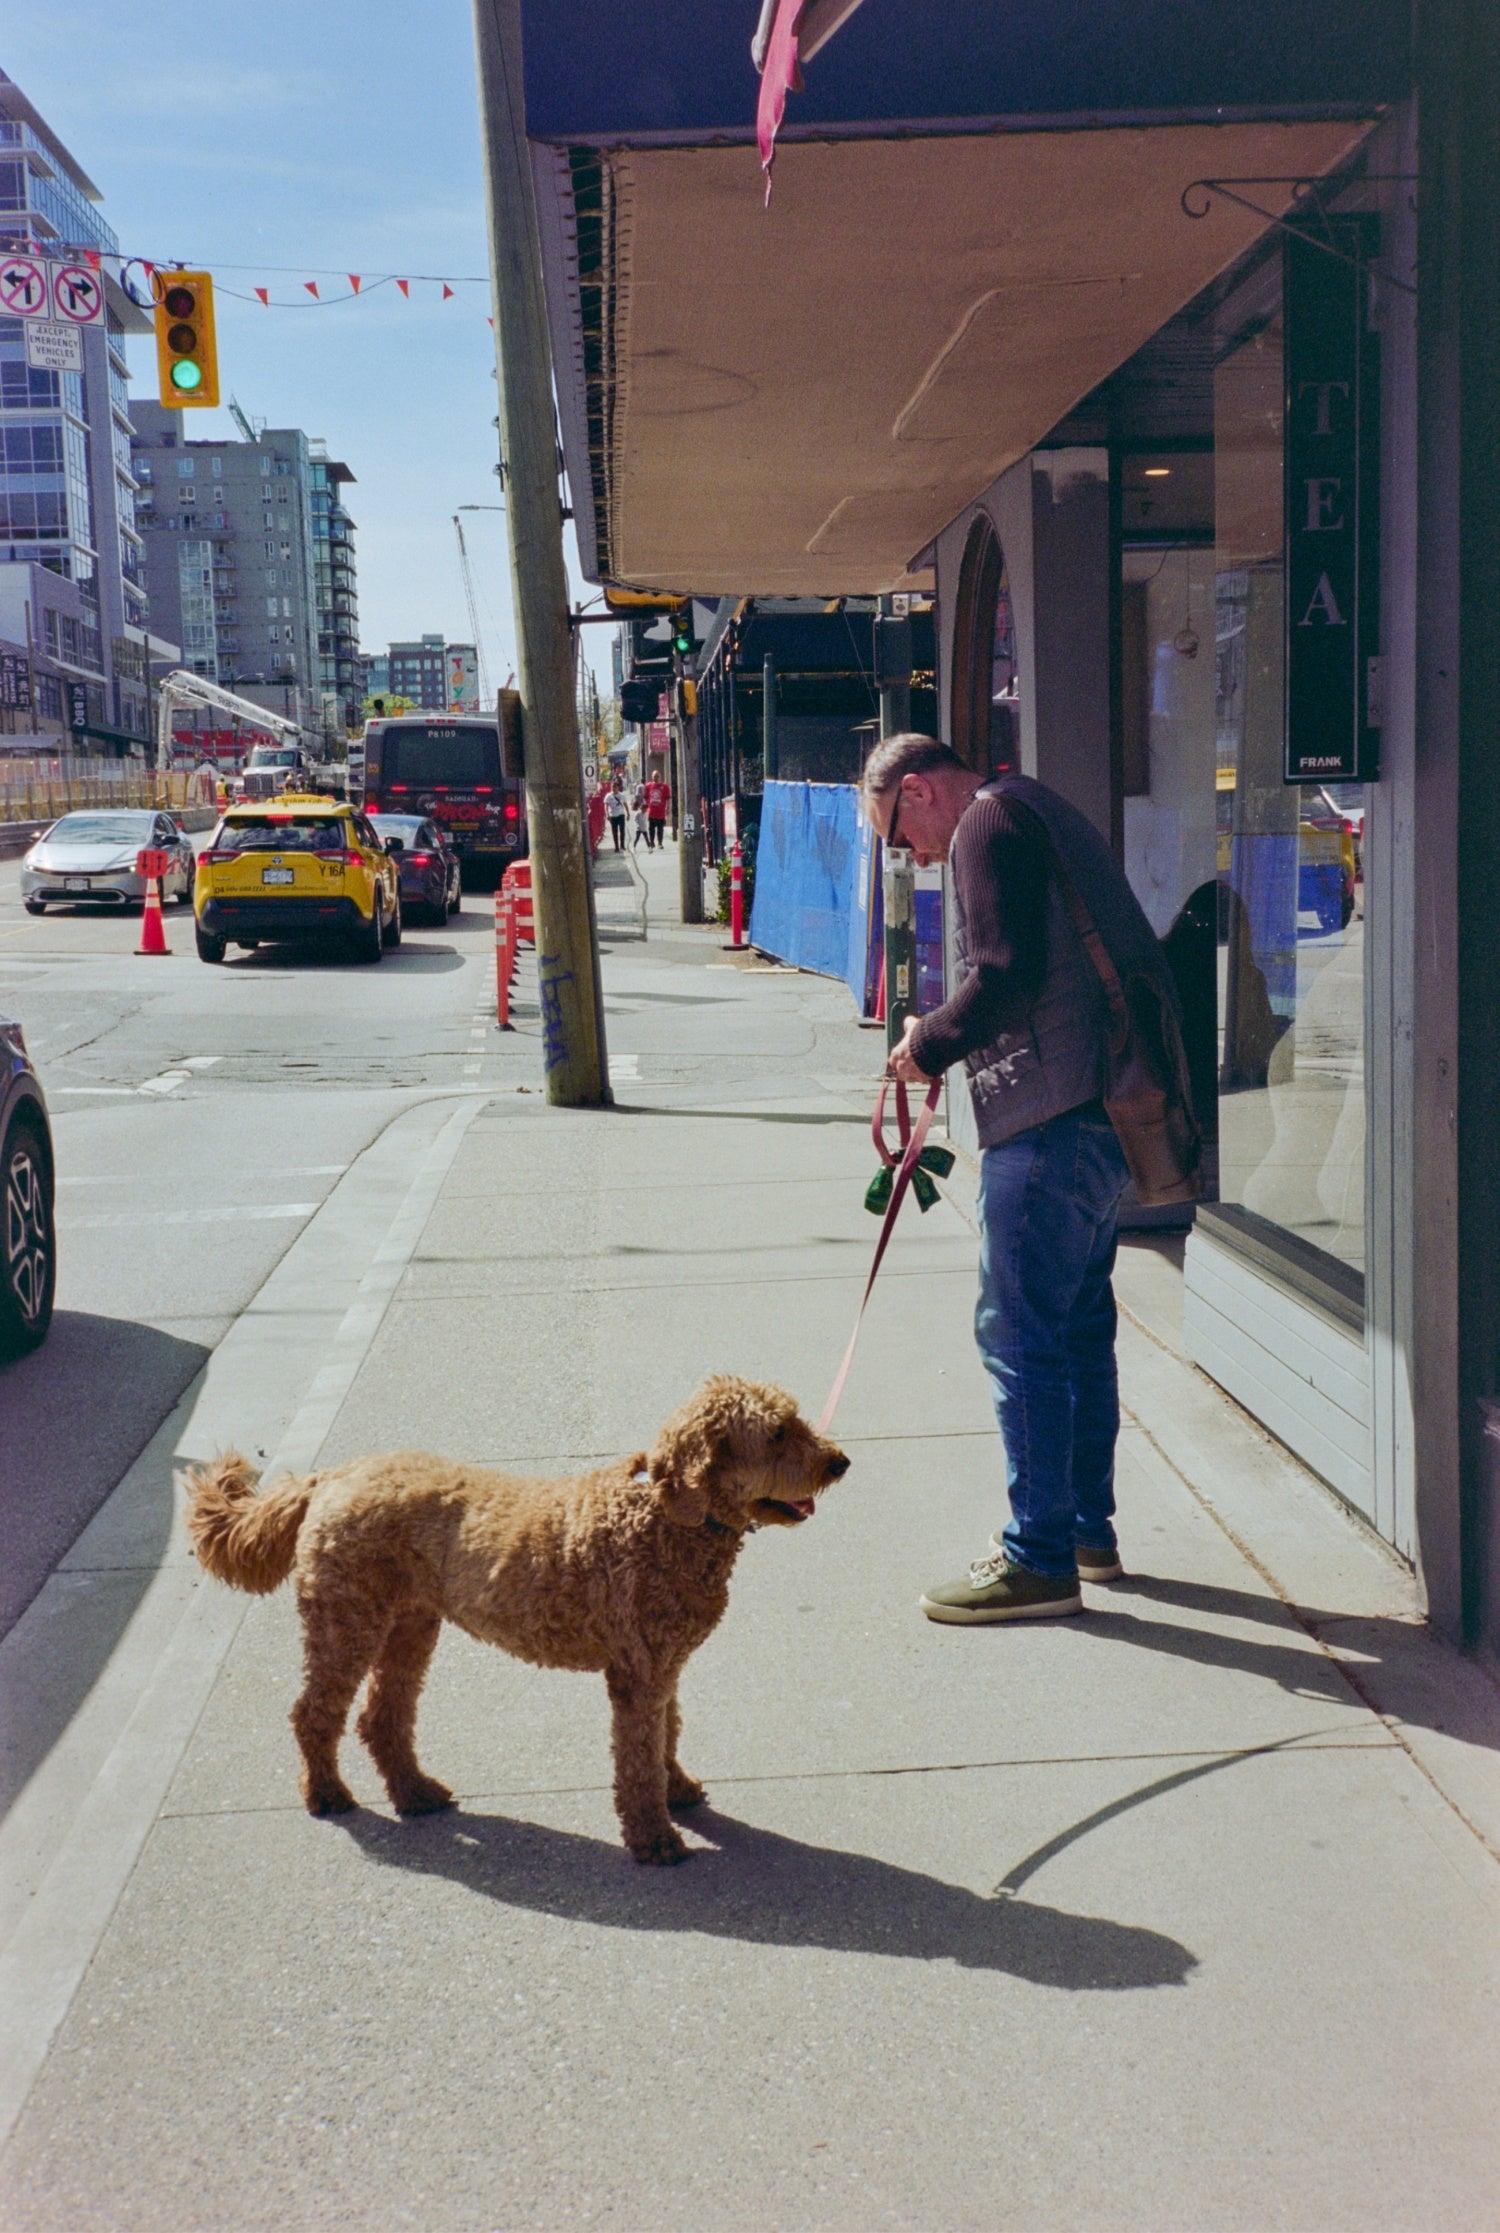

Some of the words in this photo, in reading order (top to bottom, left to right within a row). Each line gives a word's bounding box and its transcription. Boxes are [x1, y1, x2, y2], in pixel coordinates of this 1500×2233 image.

[38, 326, 67, 336] EXCEPT
[30, 335, 78, 348] EMERGENCY
[36, 346, 74, 358] VEHICLES
[45, 357, 66, 366] ONLY
[1298, 381, 1349, 625] TEA
[73, 702, 85, 726] BBQ
[1300, 756, 1342, 768] FRANK
[319, 866, 326, 876] Y
[329, 866, 346, 876] 16A
